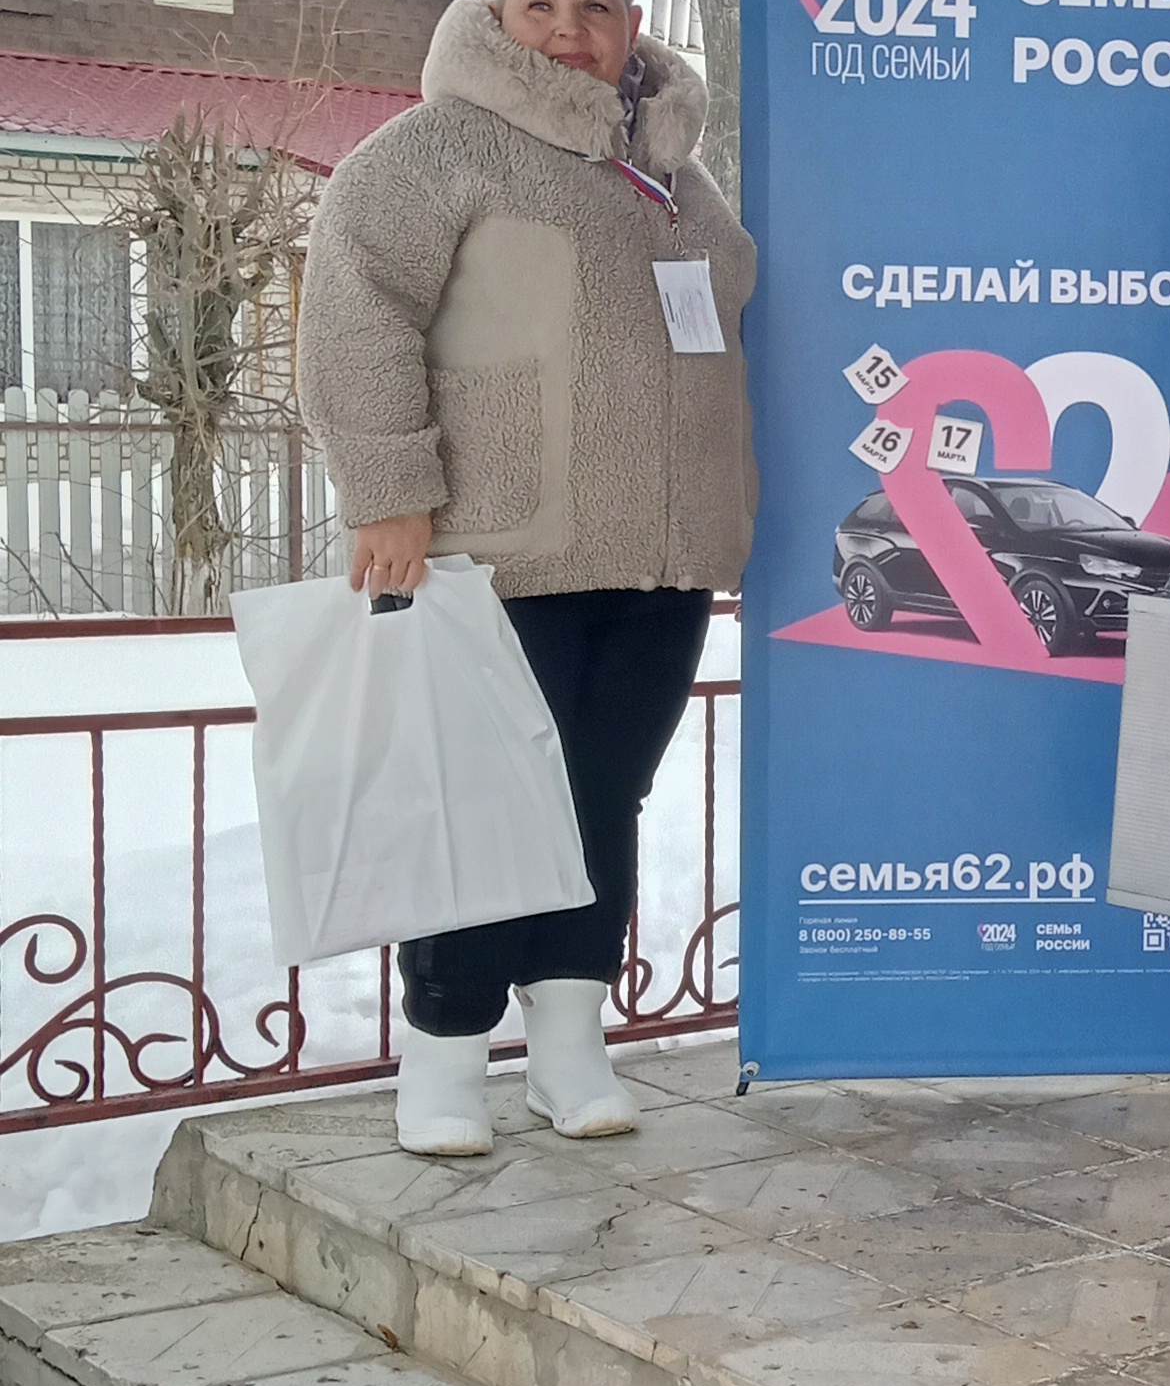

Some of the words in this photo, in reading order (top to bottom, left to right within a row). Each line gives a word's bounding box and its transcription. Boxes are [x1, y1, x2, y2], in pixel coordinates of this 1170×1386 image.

[811, 42, 866, 85] ГОД
[842, 259, 1041, 310] СДЕЛАЙ
[855, 370, 876, 396] МАРТА
[865, 355, 898, 389] 15
[870, 426, 902, 453] 16
[941, 425, 973, 450] 17
[861, 443, 888, 464] МАРТА
[937, 450, 967, 463] МАРТА
[800, 853, 1095, 898] семья62.рф
[799, 930, 809, 943] 8
[811, 928, 851, 943] (800)
[854, 928, 931, 942] 250-89-55
[982, 924, 1017, 943] 2024
[1036, 924, 1082, 936] СЕМЬЯ
[1036, 939, 1090, 951] РОССИИ
